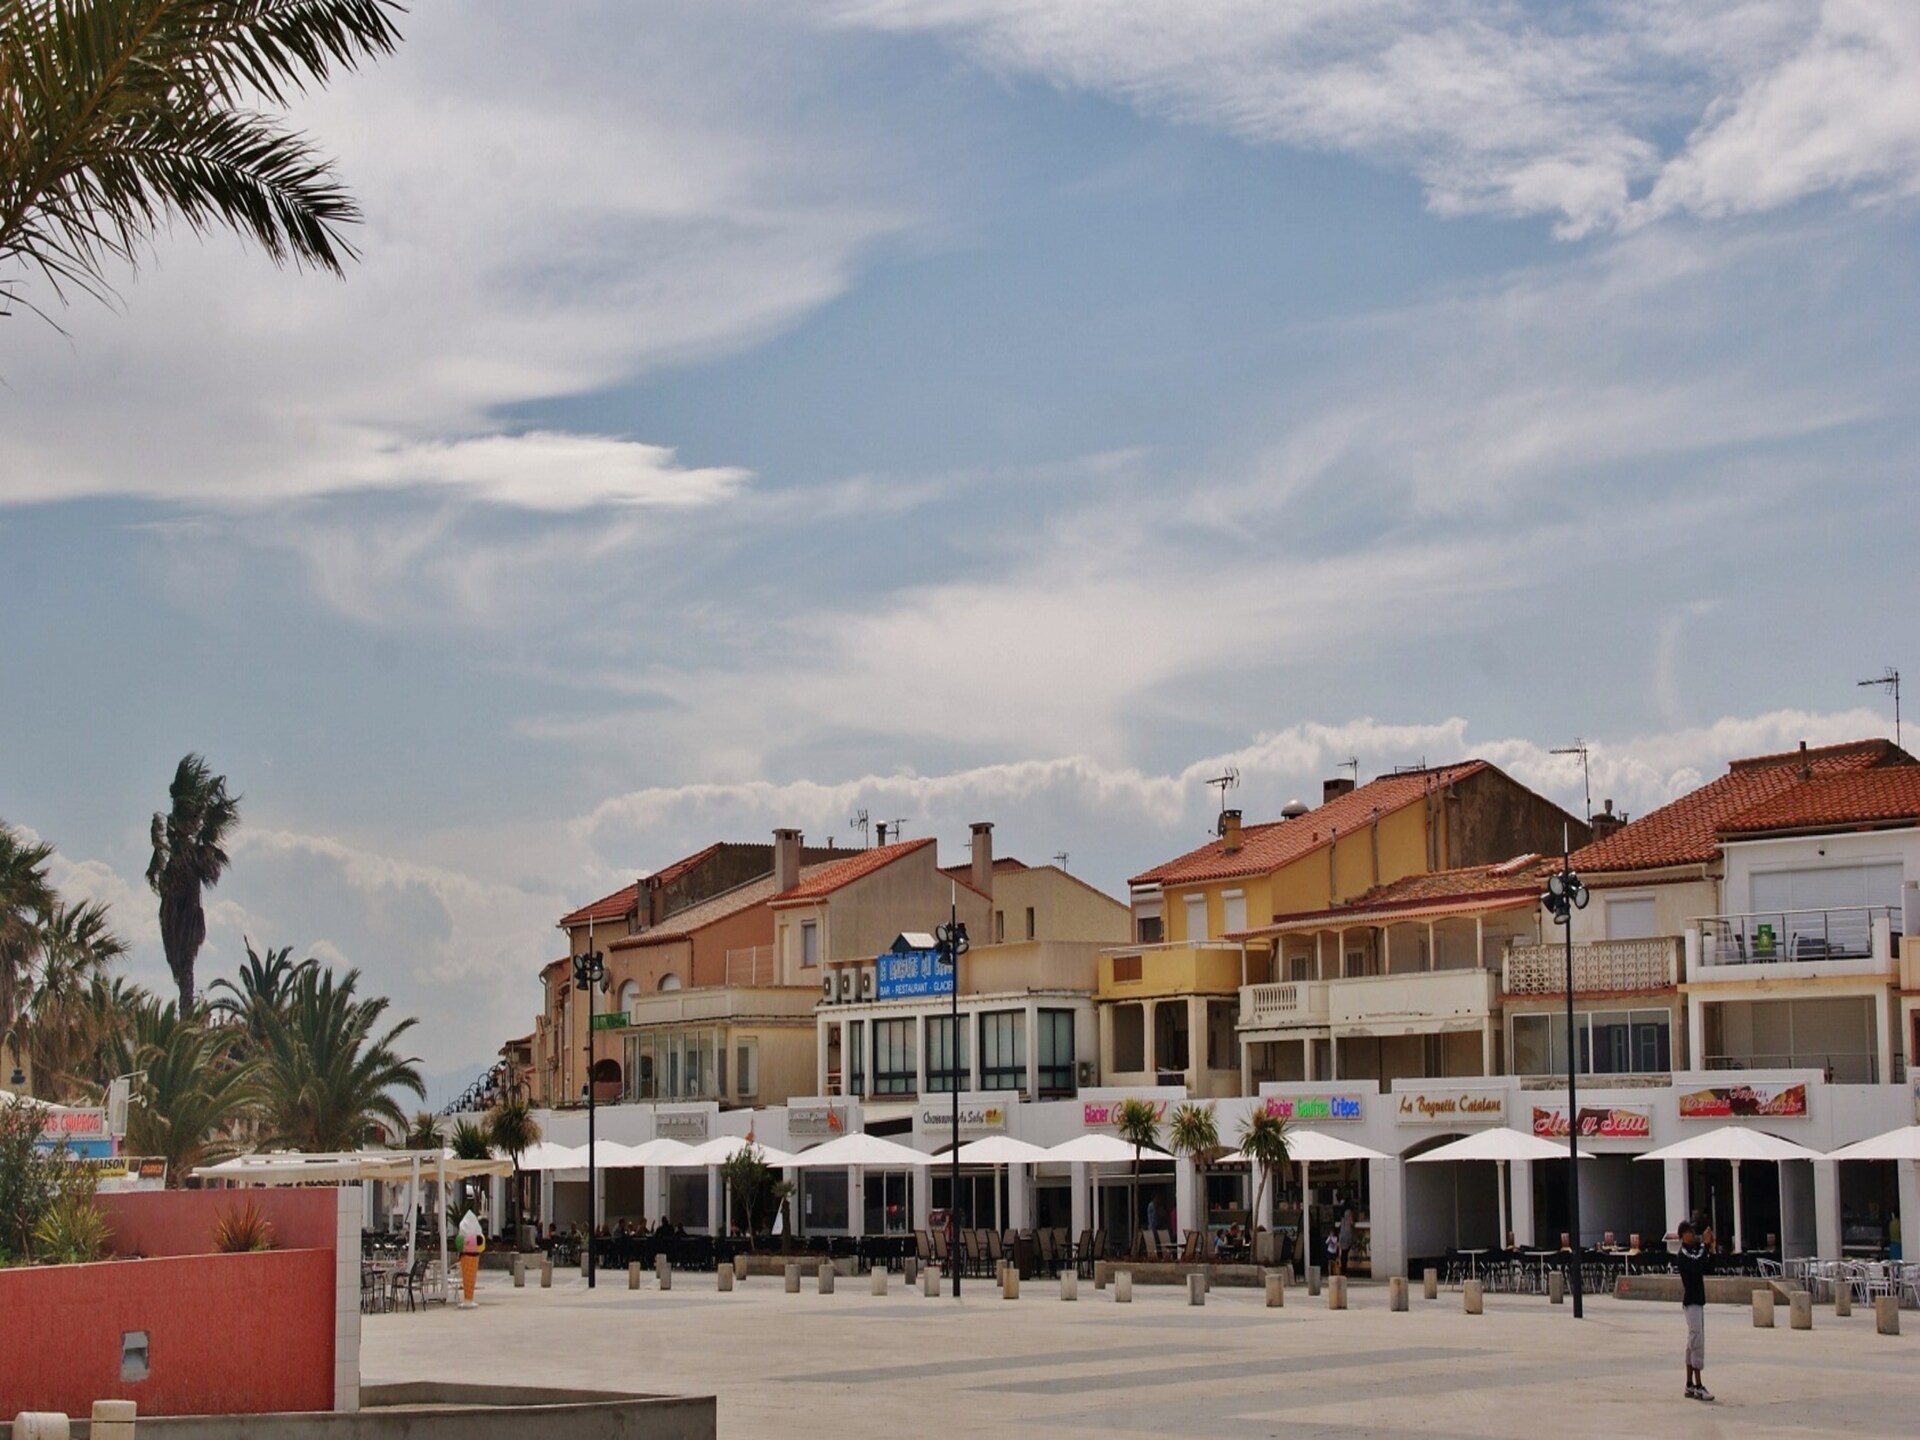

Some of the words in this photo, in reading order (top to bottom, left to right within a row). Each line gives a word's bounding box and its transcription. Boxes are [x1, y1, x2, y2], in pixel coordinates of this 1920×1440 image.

[880, 985, 890, 996] BAR
[895, 982, 928, 994] RESTAURANT
[933, 980, 953, 991] GLACIE
[1084, 1103, 1108, 1123] Glacier
[1266, 1097, 1293, 1117] Glacier
[1297, 1097, 1329, 1117] Gaufres
[1331, 1095, 1360, 1119] Crêpes
[1399, 1096, 1412, 1112] La
[1416, 1095, 1456, 1118] Baguette
[1459, 1095, 1501, 1112] Catalane
